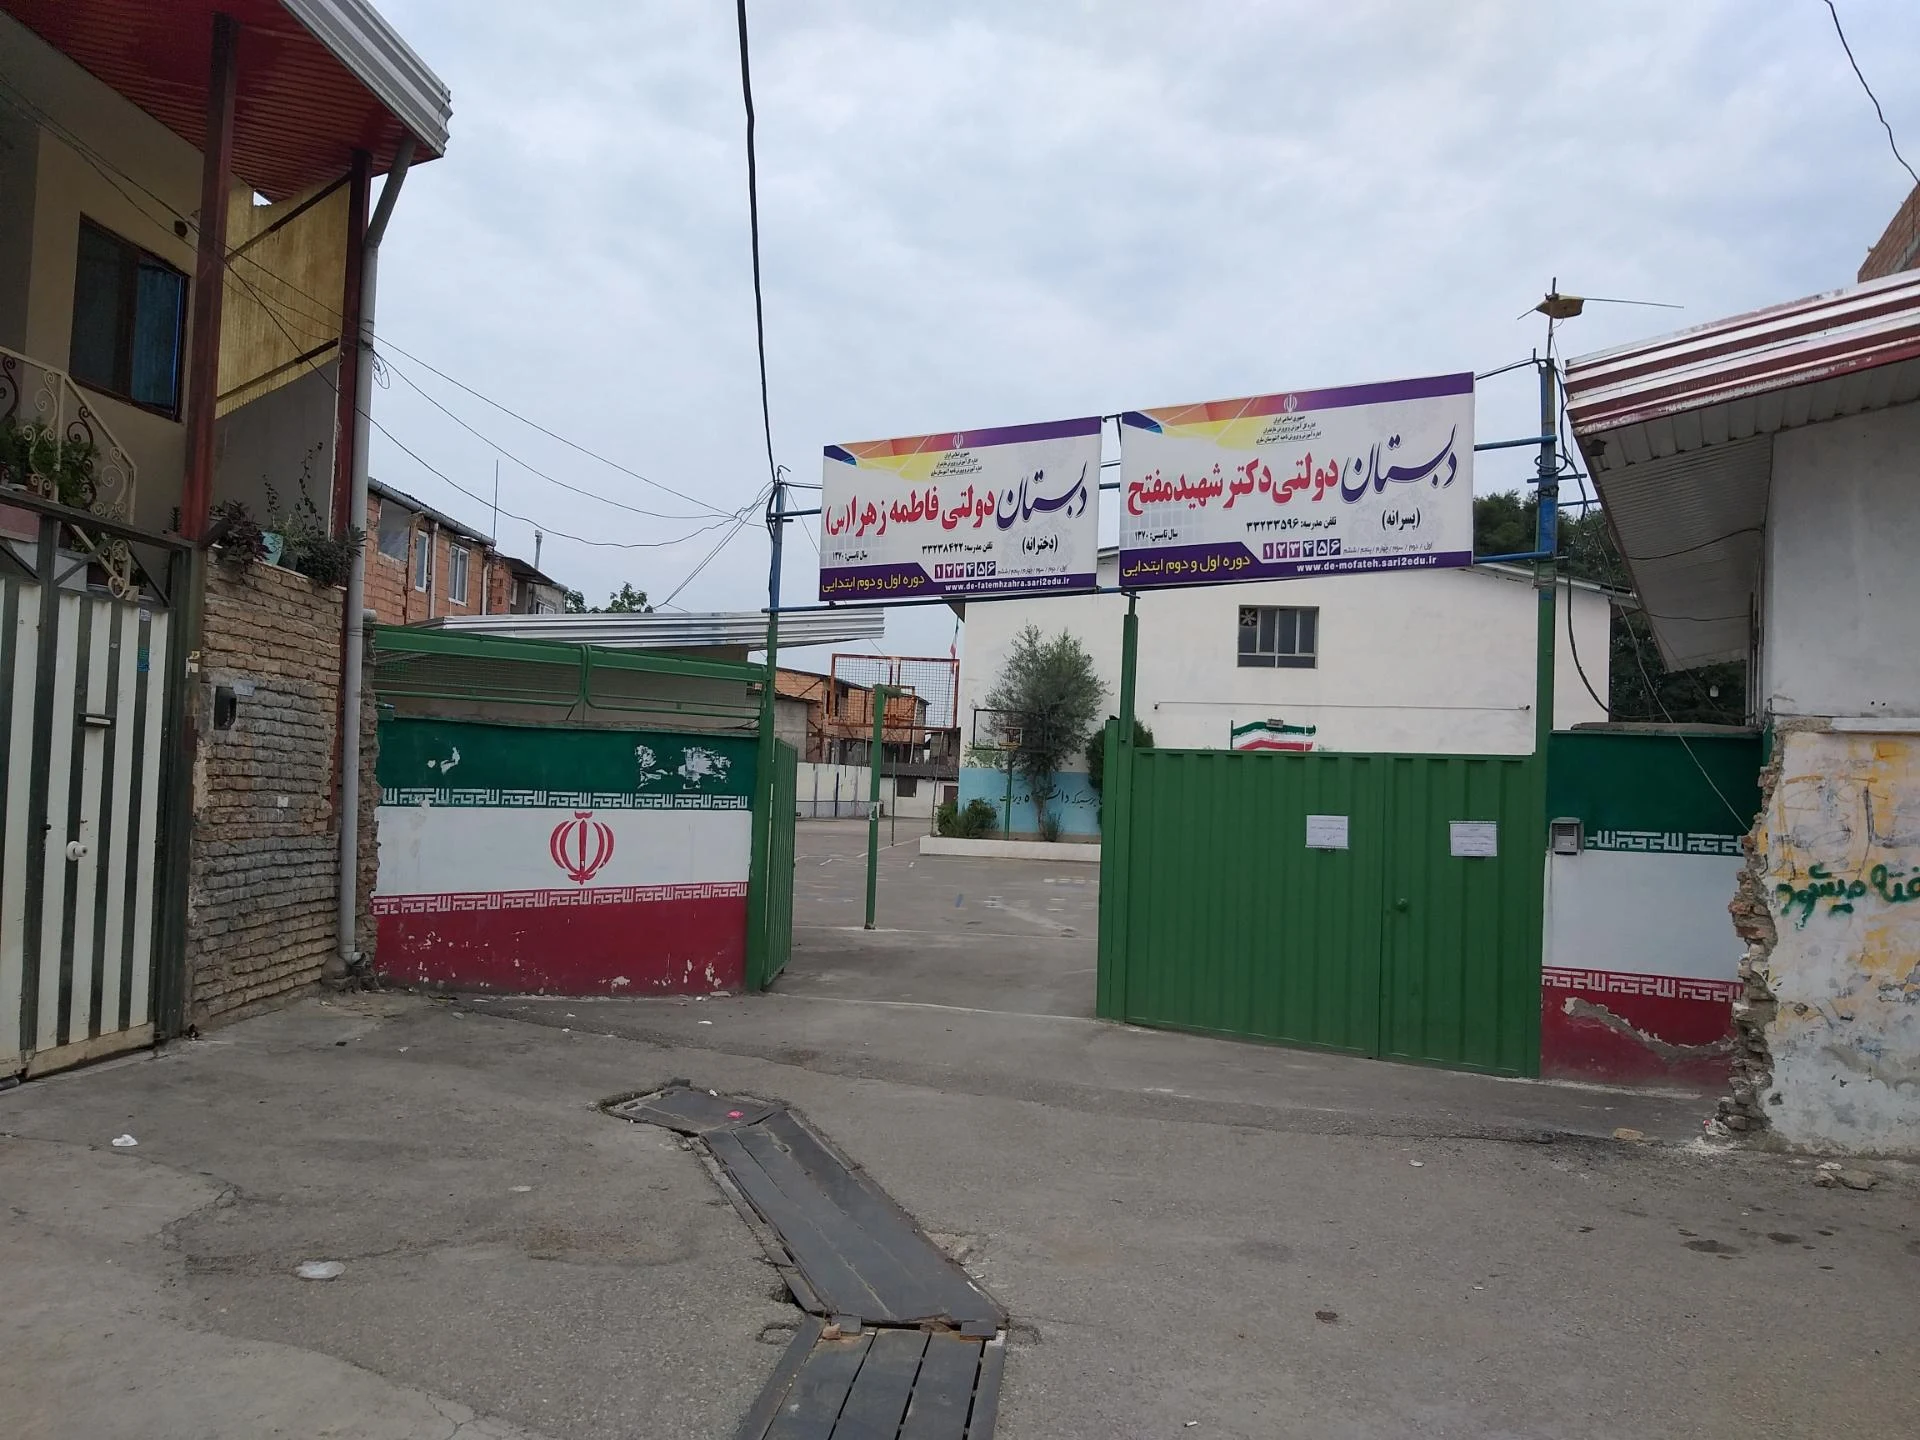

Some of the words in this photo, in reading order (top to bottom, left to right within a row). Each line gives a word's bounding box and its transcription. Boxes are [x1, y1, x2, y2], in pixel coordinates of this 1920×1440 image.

[1341, 424, 1457, 502] دبستان
[1174, 463, 1224, 510] شهید
[1223, 458, 1272, 508] دکتر
[1272, 452, 1338, 504] دولتی
[997, 460, 1087, 529] دبستان
[1127, 469, 1174, 515] مفتح
[890, 486, 939, 522] فاطمه
[941, 484, 995, 530] دولتی
[1324, 516, 1336, 529] تلفن
[1382, 508, 1420, 531] (پسرانه)
[1022, 534, 1058, 555] (دخترانه)
[1122, 558, 1163, 576] ابتدایی
[1166, 560, 1188, 574] دوم
[1191, 560, 1197, 572] و
[1200, 555, 1220, 572] اول
[1223, 556, 1251, 570] دوره
[822, 577, 855, 592] ابتدایی
[857, 579, 876, 590] دوم
[877, 579, 883, 589] و
[884, 573, 901, 589] اول
[903, 575, 925, 588] دوره
